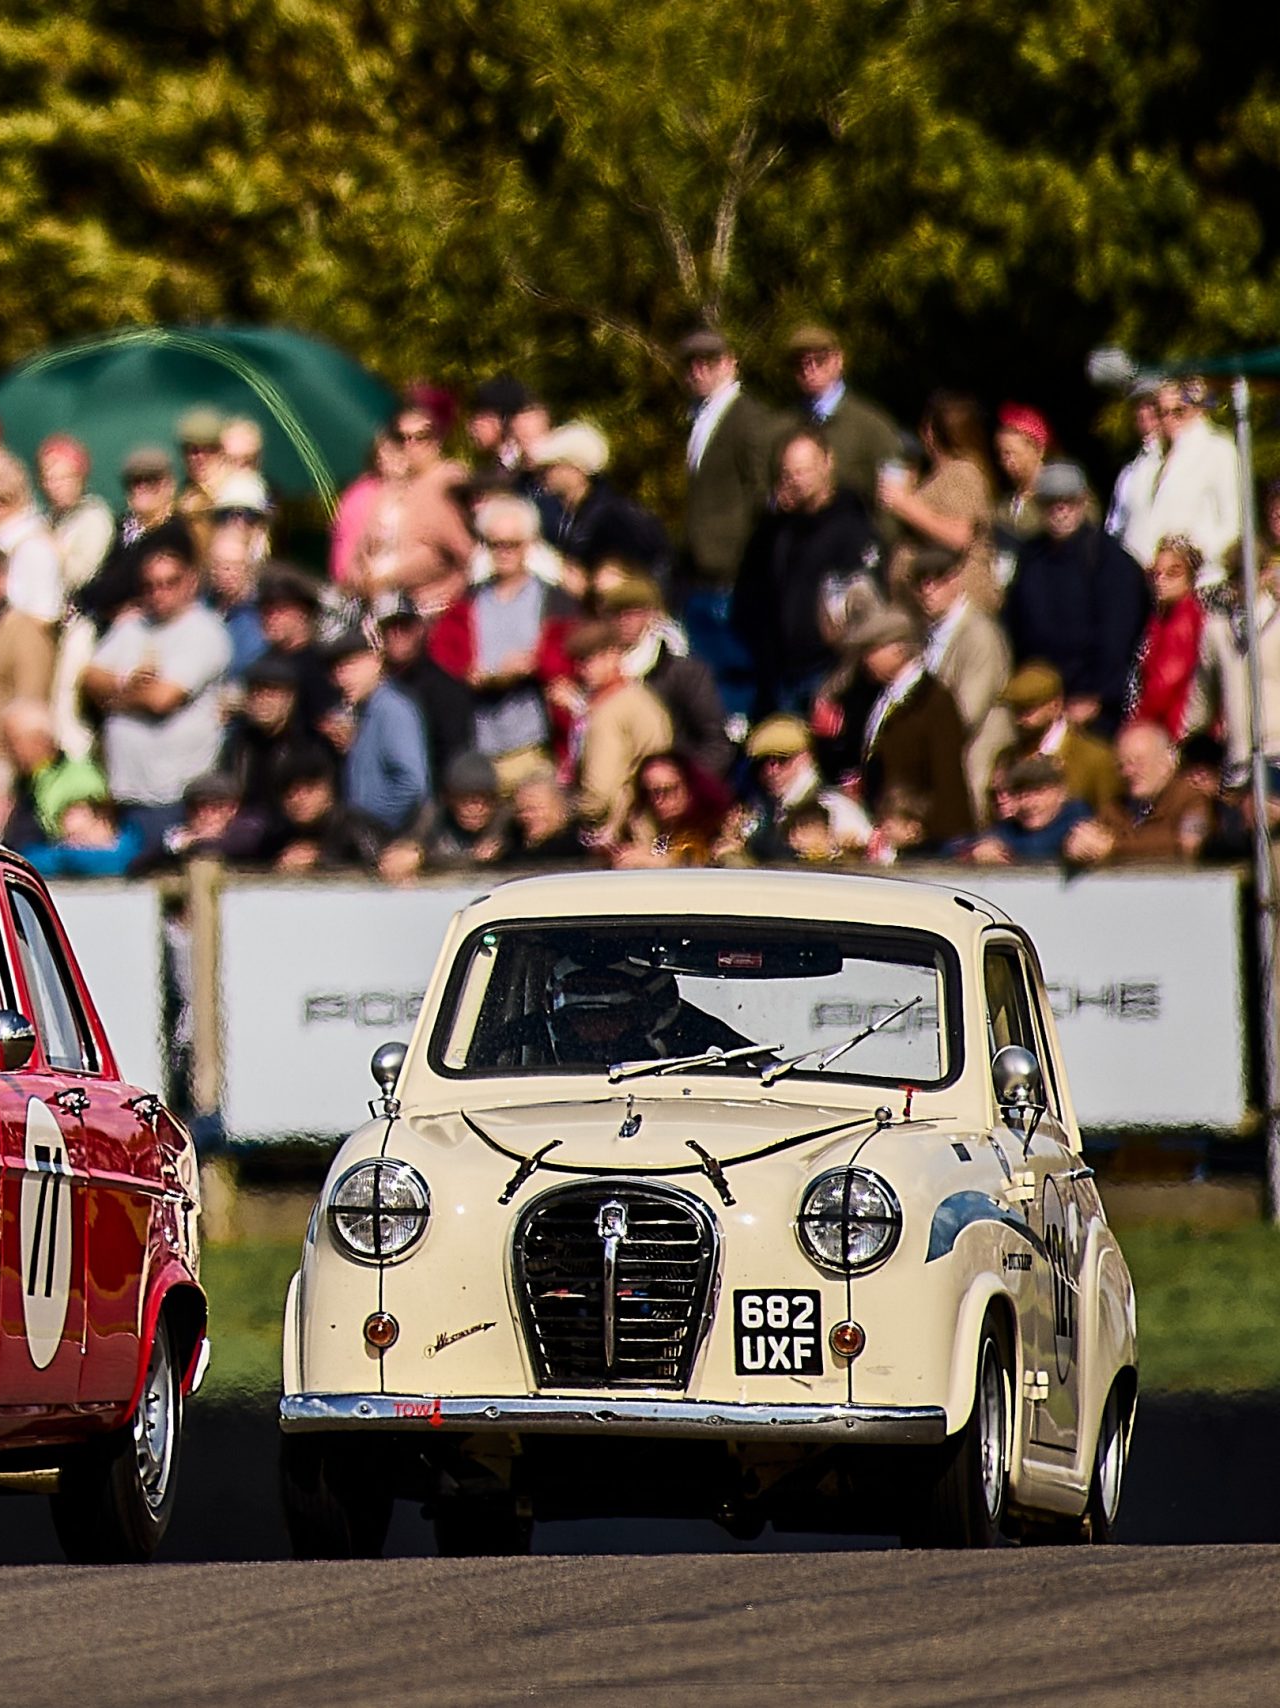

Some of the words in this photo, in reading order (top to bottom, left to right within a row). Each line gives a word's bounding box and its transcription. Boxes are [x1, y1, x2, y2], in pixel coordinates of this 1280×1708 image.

[741, 1295, 815, 1330] 682
[742, 1336, 815, 1370] UXF
[393, 1402, 433, 1418] TOW
